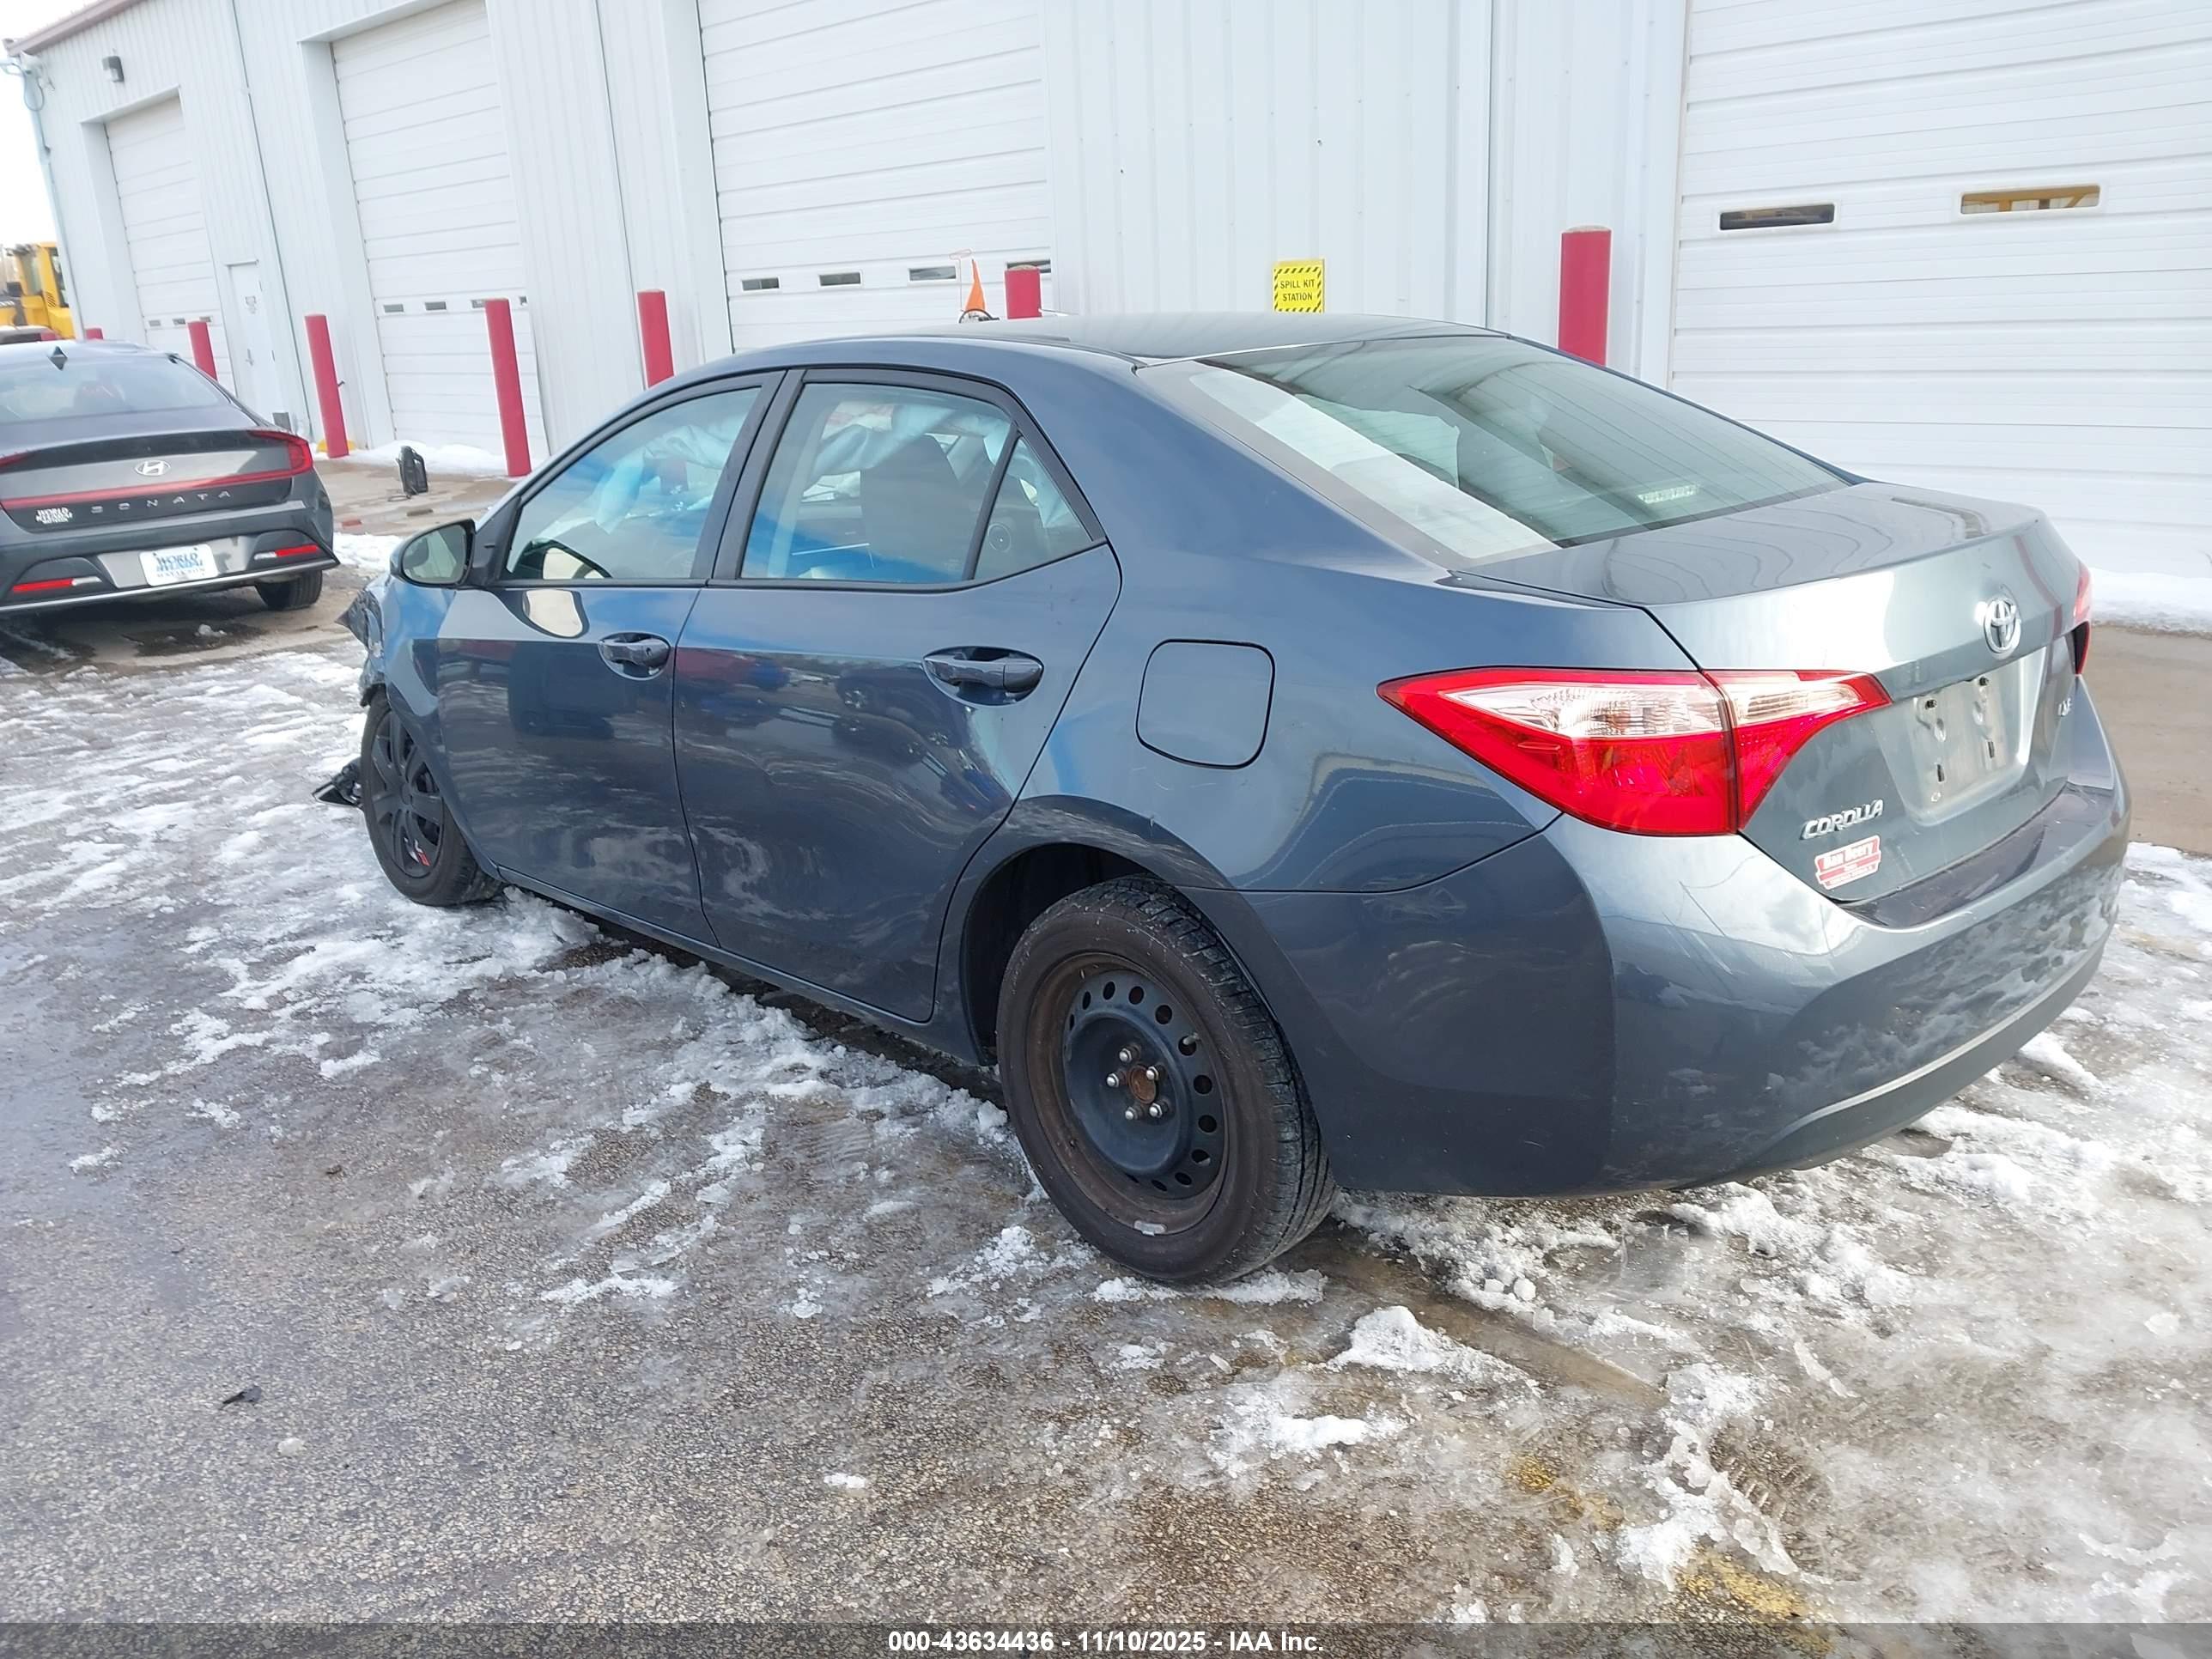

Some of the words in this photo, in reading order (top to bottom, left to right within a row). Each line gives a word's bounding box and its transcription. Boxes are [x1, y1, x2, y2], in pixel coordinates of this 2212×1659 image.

[1304, 279, 1315, 288] KIT
[1283, 292, 1313, 302] STATION
[91, 490, 231, 514] SONATA
[1802, 799, 1884, 840] COROLLA
